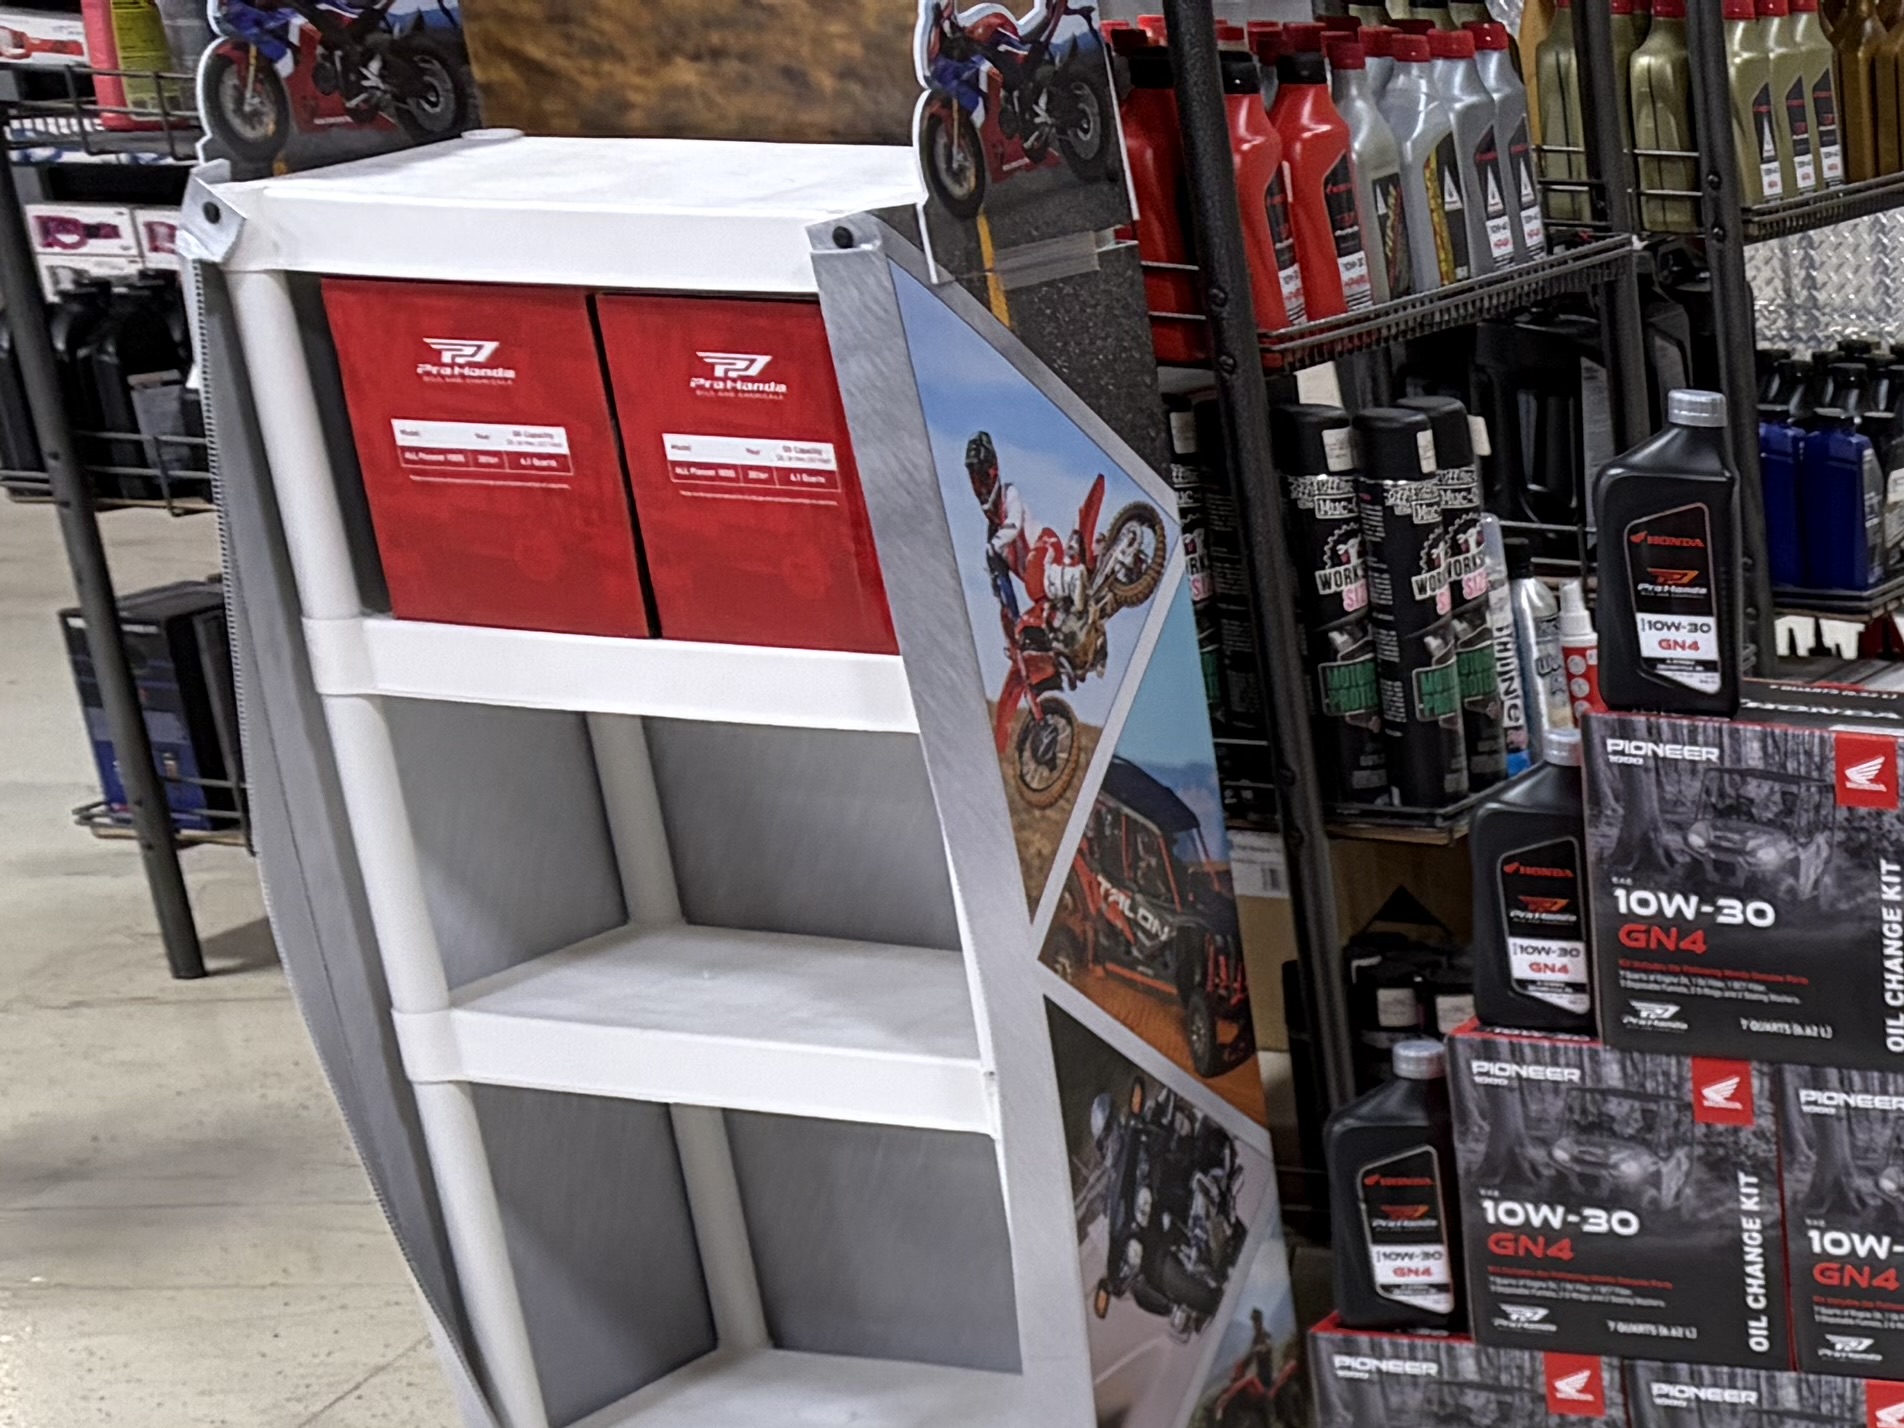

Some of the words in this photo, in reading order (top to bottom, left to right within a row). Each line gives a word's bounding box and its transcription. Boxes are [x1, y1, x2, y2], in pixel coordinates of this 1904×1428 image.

[1647, 535, 1705, 548] HONDA
[1646, 619, 1712, 634] 10W-30
[1657, 638, 1700, 652] GN4
[1606, 738, 1720, 763] PIONEER
[1879, 859, 1901, 902] KIT
[1097, 874, 1176, 942] TALON
[1613, 888, 1776, 928] 10W-30
[1519, 944, 1581, 958] 10W-30
[1618, 923, 1707, 955] GN4
[1528, 962, 1570, 975] GN4
[1471, 1060, 1581, 1082] PIONEER
[1737, 1170, 1760, 1205] KIT
[1481, 1199, 1640, 1236] 10W-30
[1381, 1249, 1443, 1262] 10W-30
[1487, 1232, 1575, 1261] GN4
[1392, 1265, 1434, 1278] GN4
[1741, 1217, 1768, 1311] CHANGE
[1812, 1262, 1900, 1291] GN4
[1748, 1315, 1770, 1352] OIL
[1333, 1355, 1438, 1376] PIONEER
[1651, 1382, 1758, 1404] PIONEER
